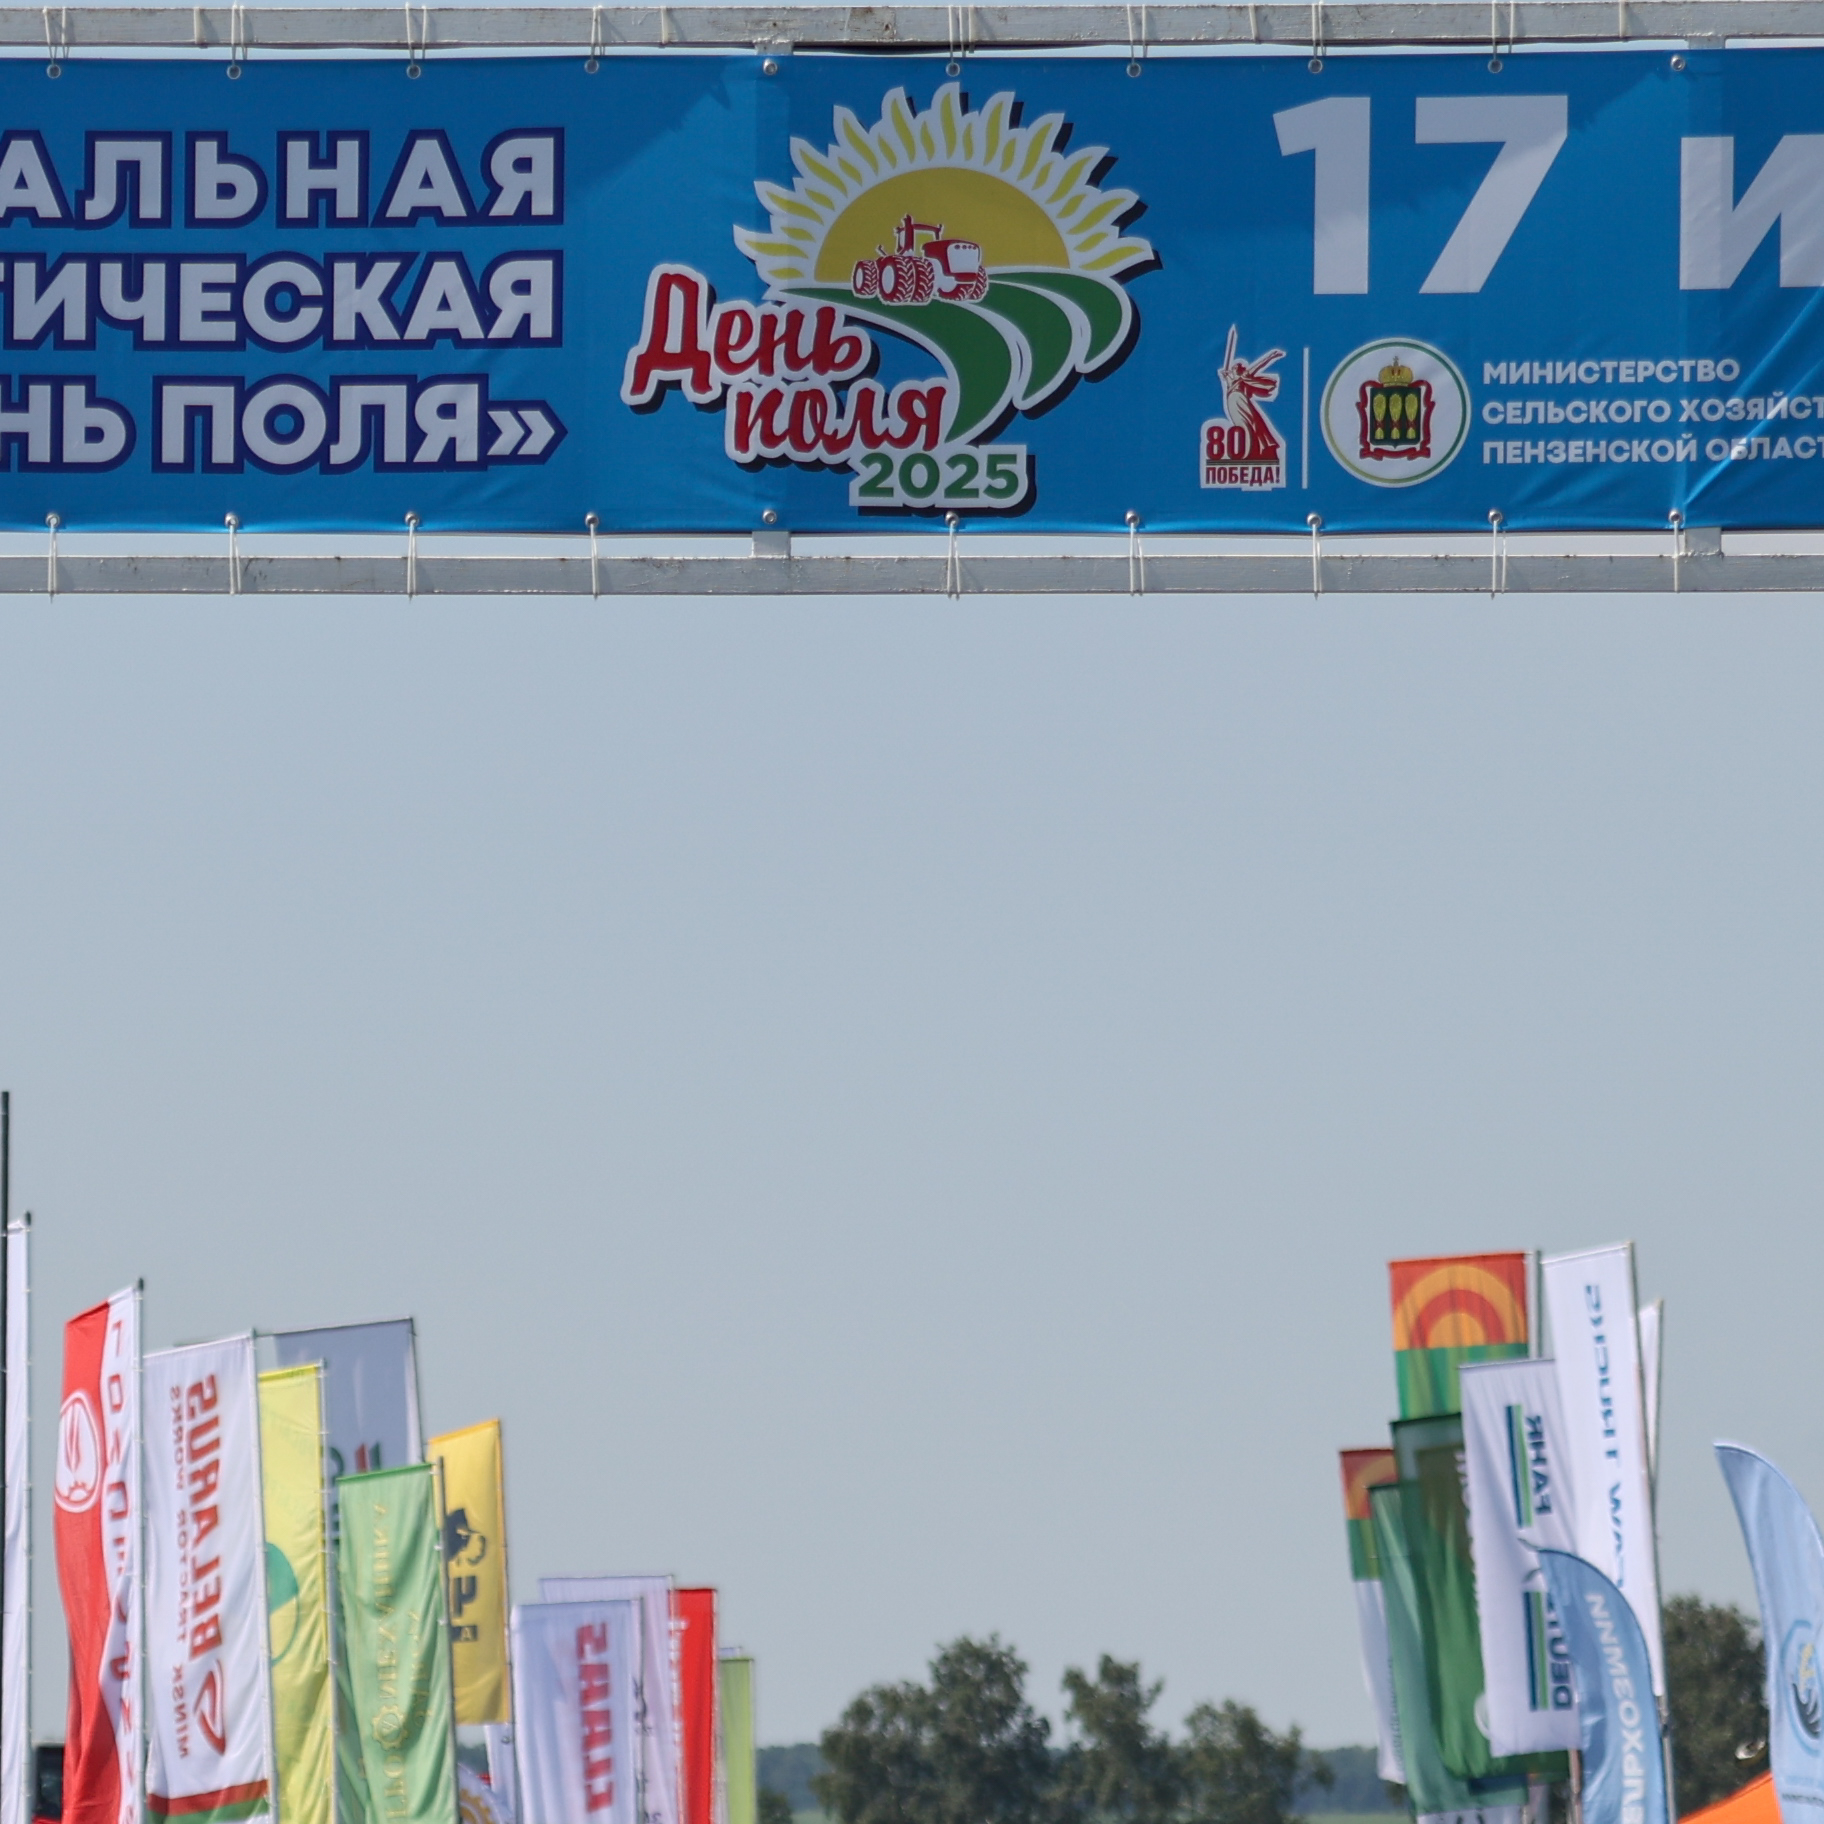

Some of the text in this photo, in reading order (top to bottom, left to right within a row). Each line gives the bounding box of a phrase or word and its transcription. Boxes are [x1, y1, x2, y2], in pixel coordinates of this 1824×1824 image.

[1275, 96, 1569, 297] 17
[631, 273, 863, 396] День
[1483, 359, 1740, 385] МИНИСТЕРСТВО
[164, 380, 558, 466] ПОЛЯ»
[733, 383, 948, 453] поля
[1482, 399, 1672, 425] СЕЛЬСКОГО
[1482, 433, 1697, 464] ПЕНЗЕНСКОЙ
[857, 453, 1019, 499] 2025
[1205, 464, 1281, 486] ПОБЕДА!
